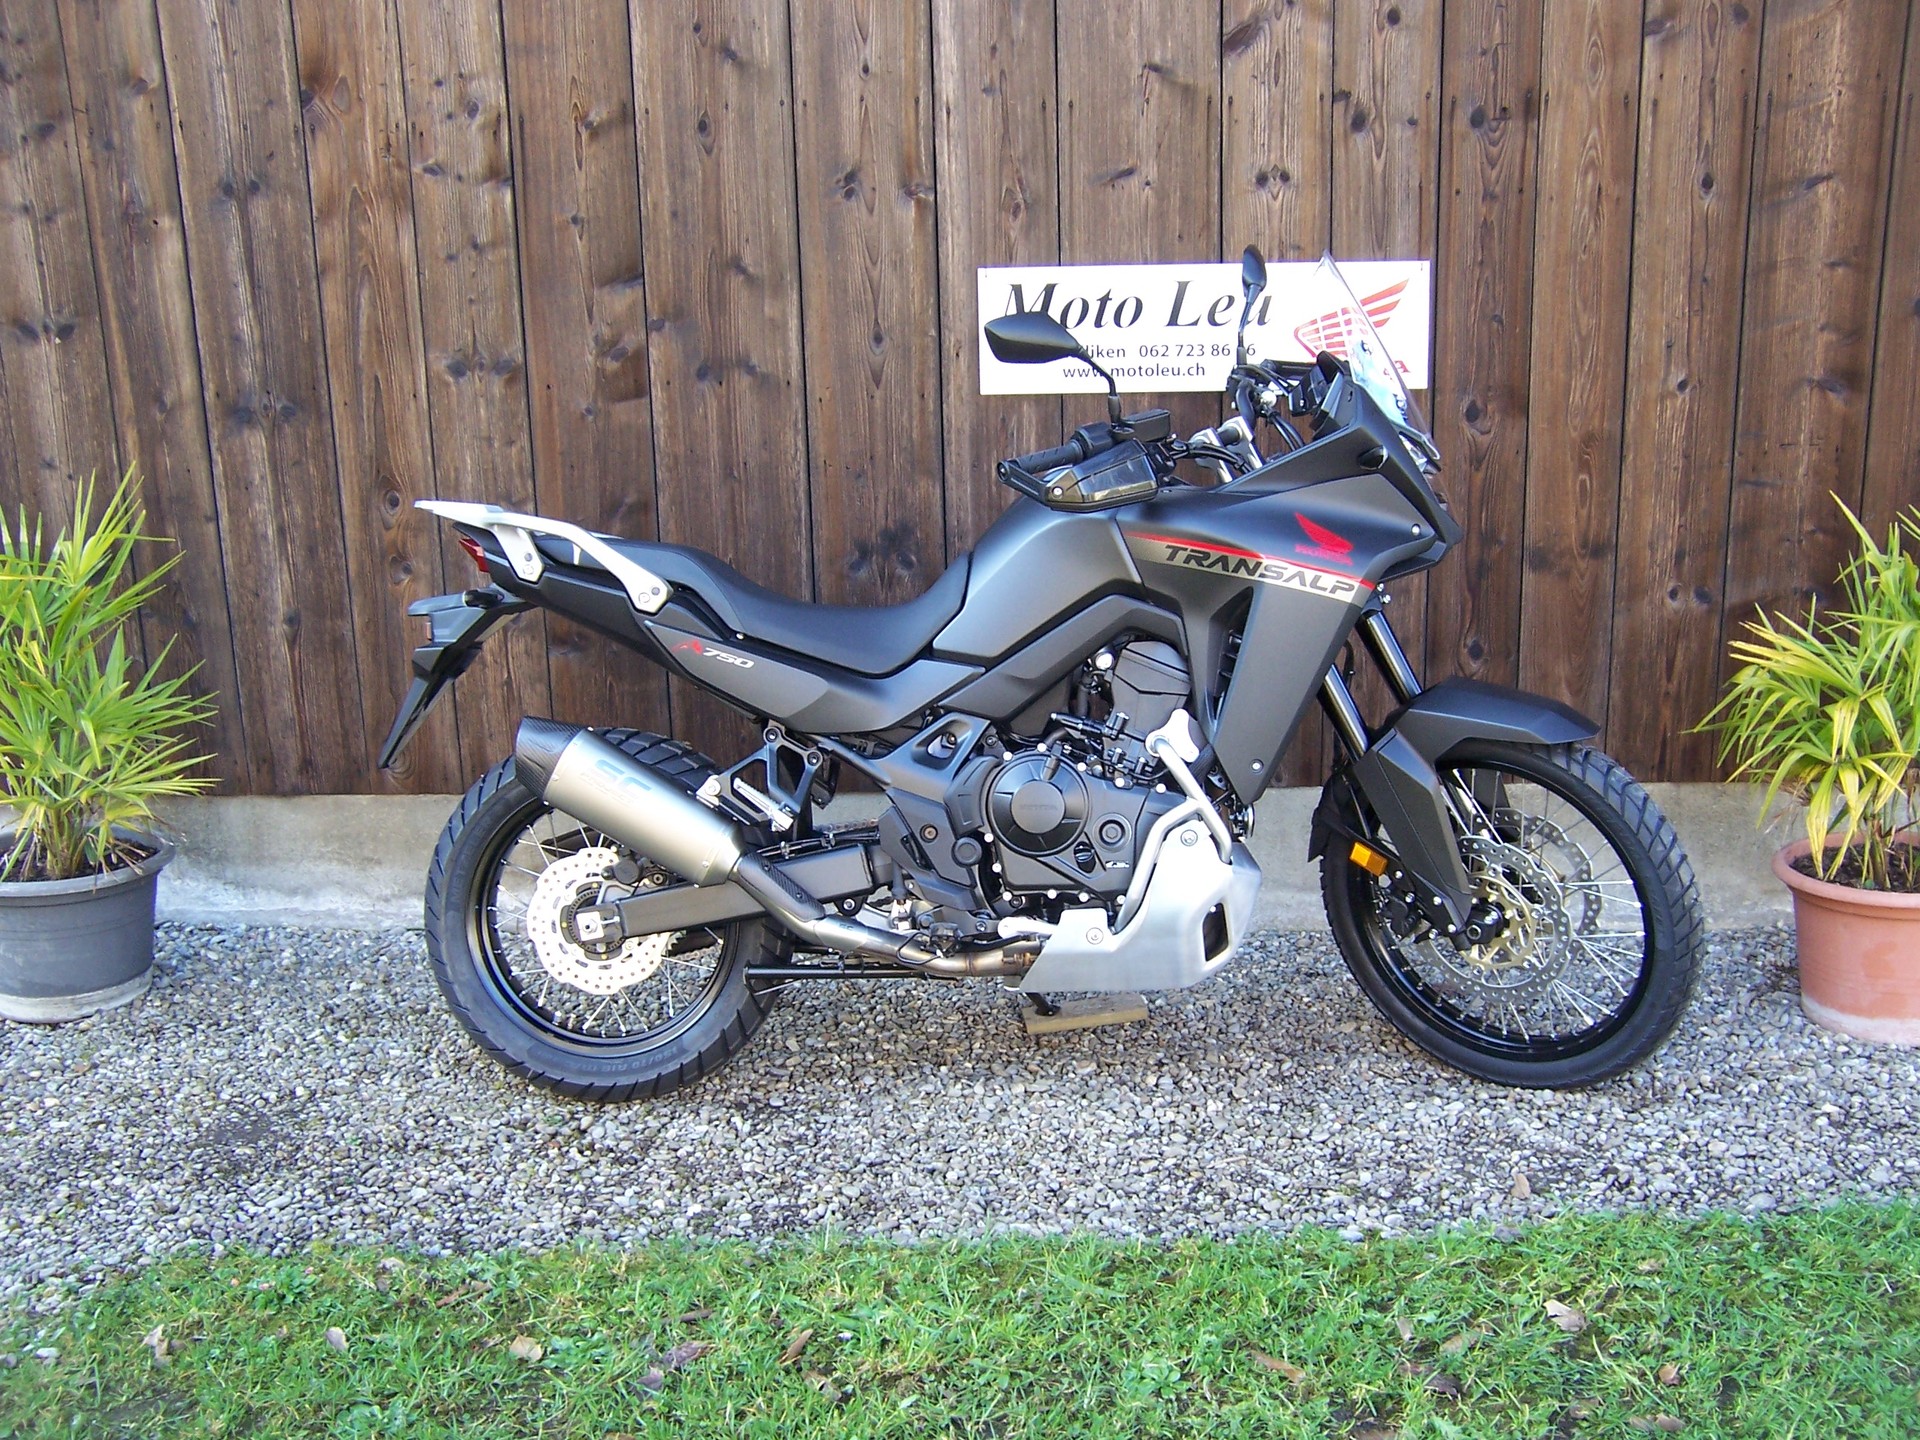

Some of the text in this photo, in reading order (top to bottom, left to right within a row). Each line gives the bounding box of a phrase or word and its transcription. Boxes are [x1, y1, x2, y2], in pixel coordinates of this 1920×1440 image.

[1004, 279, 1272, 330] Moto Leu
[1139, 344, 1170, 357] 062
[1174, 343, 1206, 357] 723
[1211, 343, 1231, 357] 86
[1062, 363, 1206, 378] wwwmotoleu.ch
[1164, 544, 1356, 596] TRANSALP
